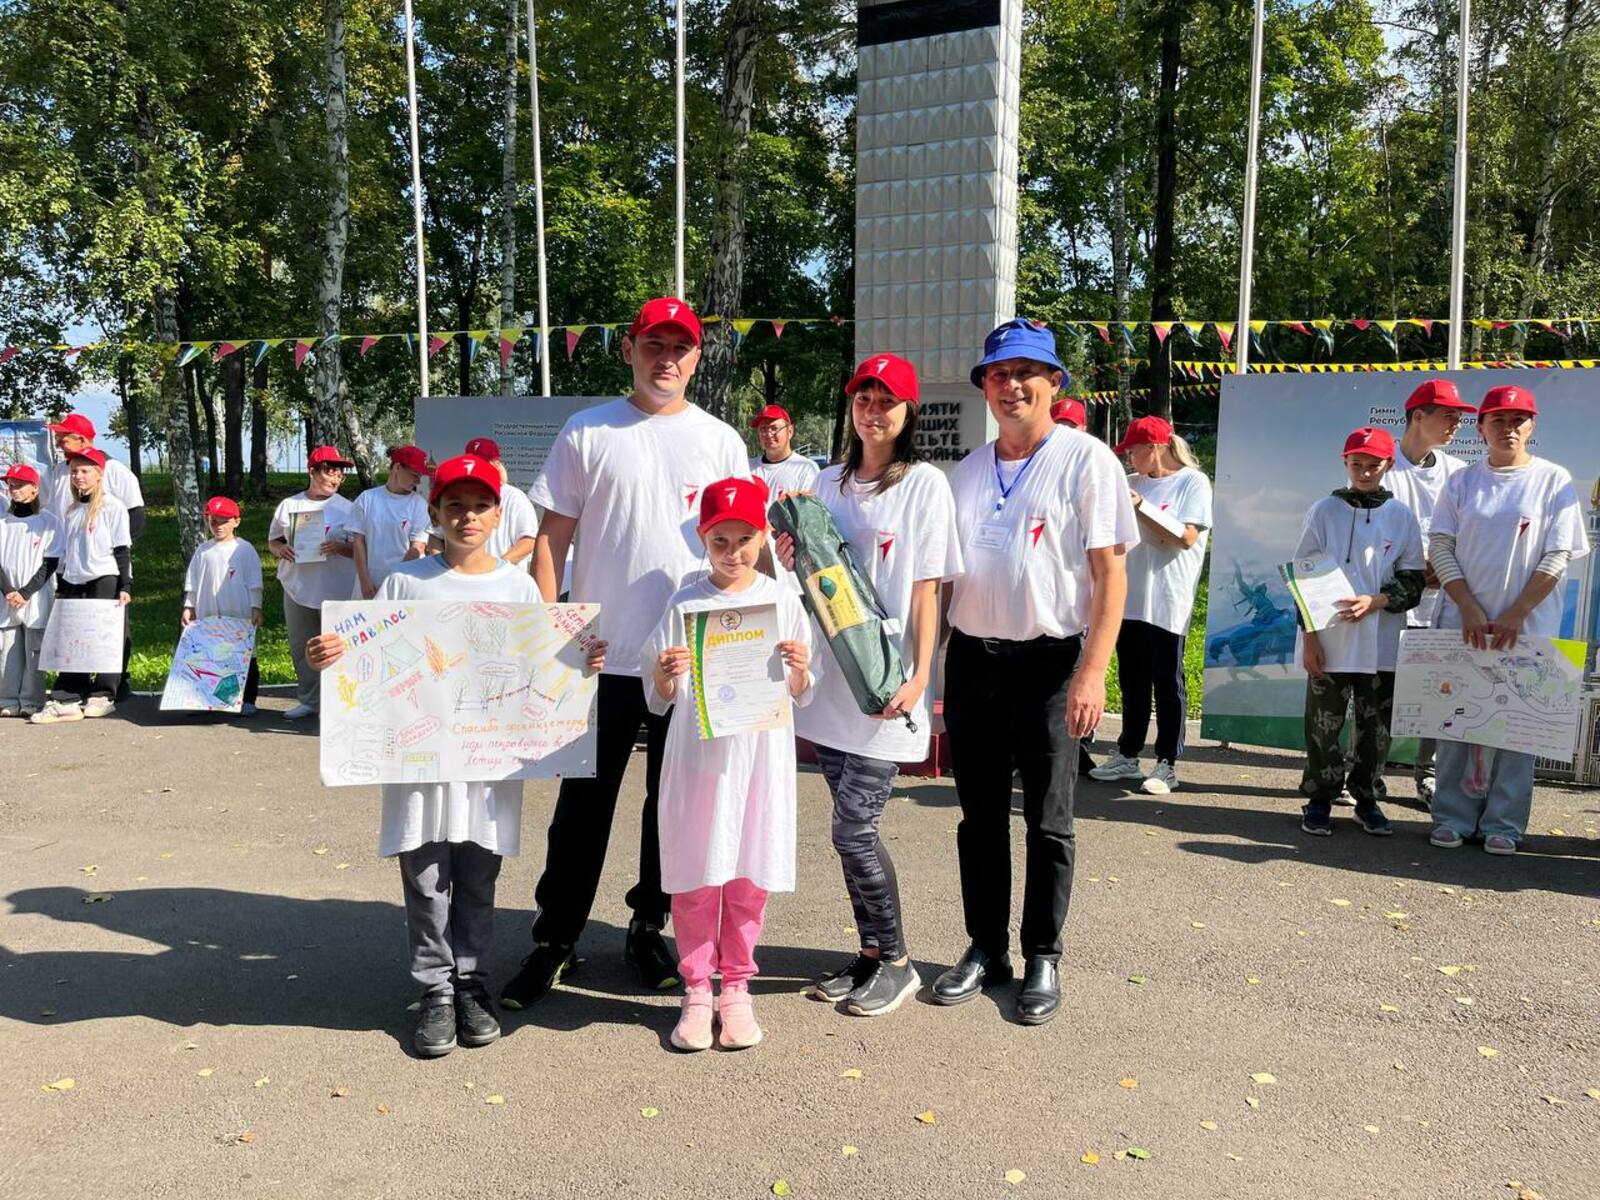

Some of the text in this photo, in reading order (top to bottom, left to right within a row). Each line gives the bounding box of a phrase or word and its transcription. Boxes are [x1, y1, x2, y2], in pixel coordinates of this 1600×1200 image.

[1370, 407, 1396, 415] Гимн
[1369, 416, 1406, 426] Респуб
[334, 610, 368, 634] НАМ
[707, 630, 764, 648] ДИПЛОМ
